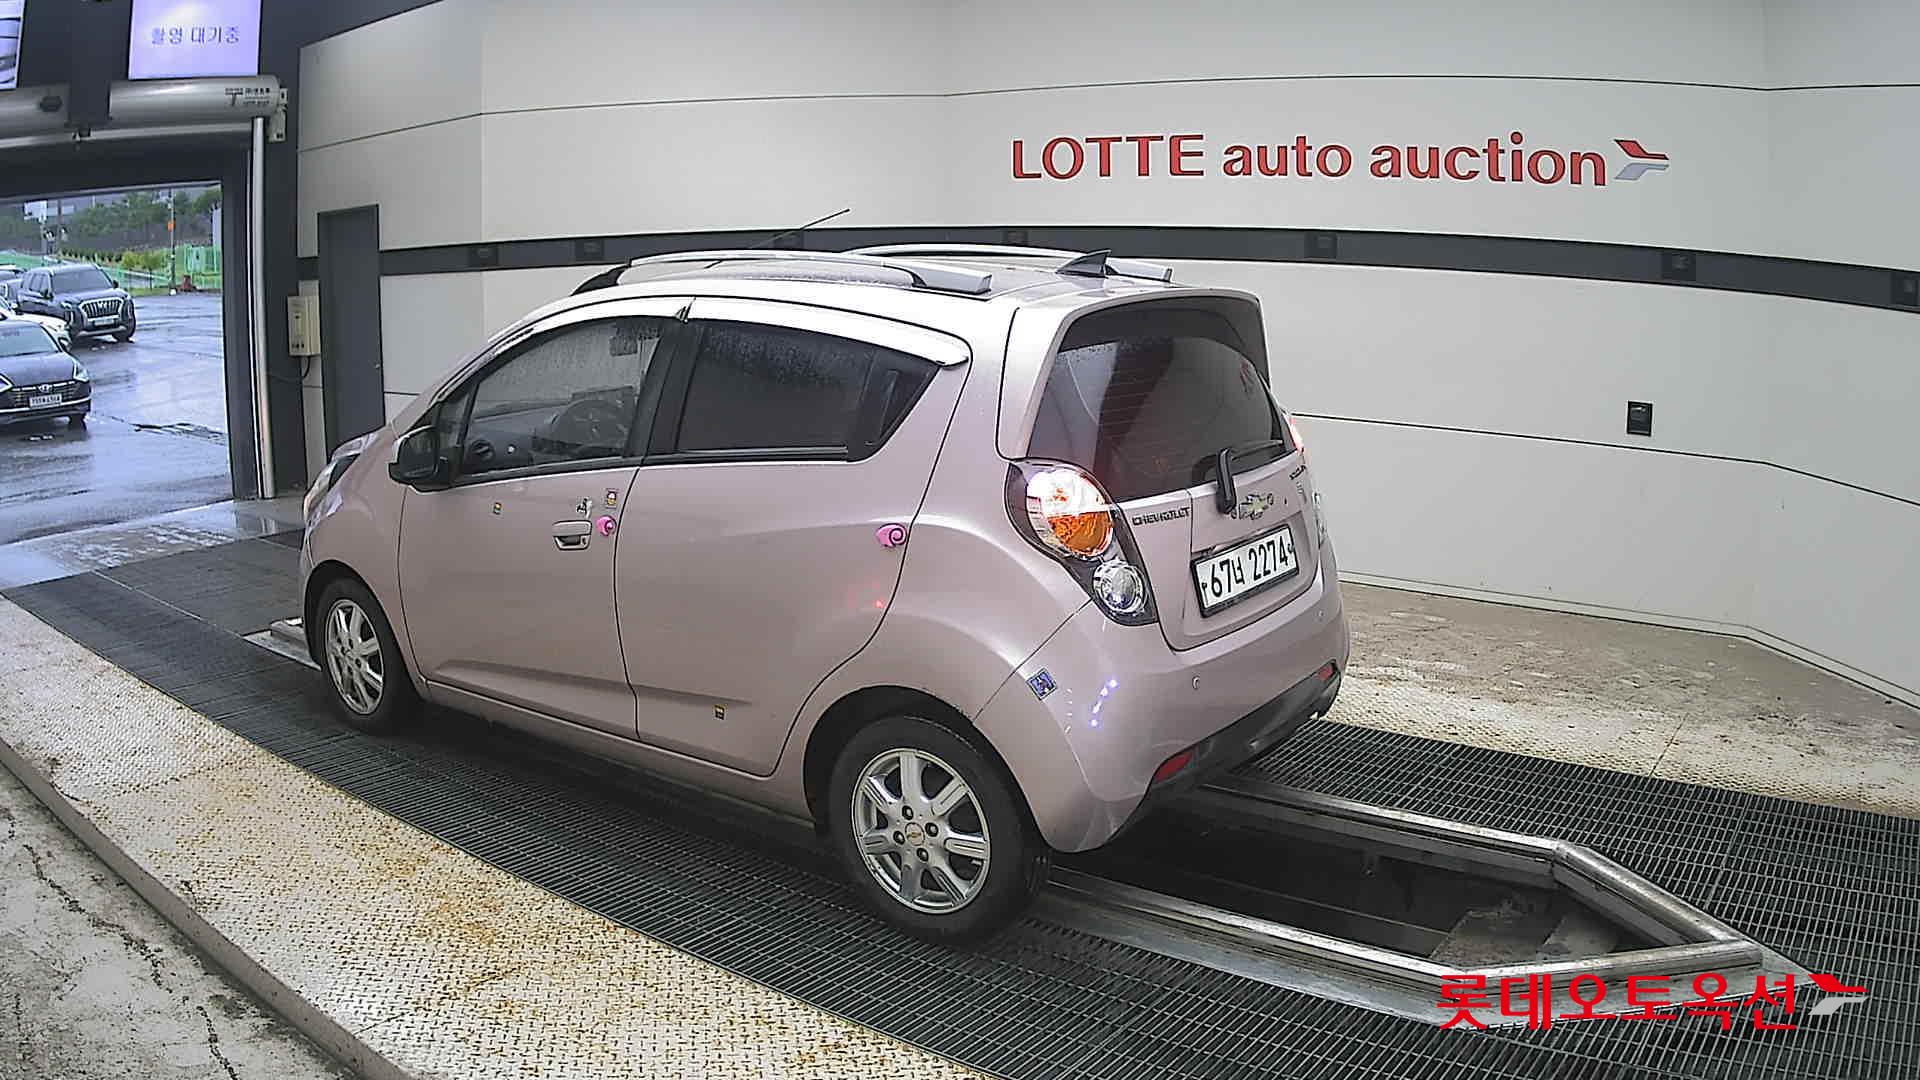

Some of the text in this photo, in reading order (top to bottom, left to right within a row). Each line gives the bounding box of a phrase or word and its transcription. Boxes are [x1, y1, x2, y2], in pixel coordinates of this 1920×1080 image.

[191, 25, 239, 45] 대기중
[1012, 131, 1606, 187] LOTTE auto auction
[1132, 506, 1190, 526] CHEVROLET
[1248, 535, 1289, 581] 2274
